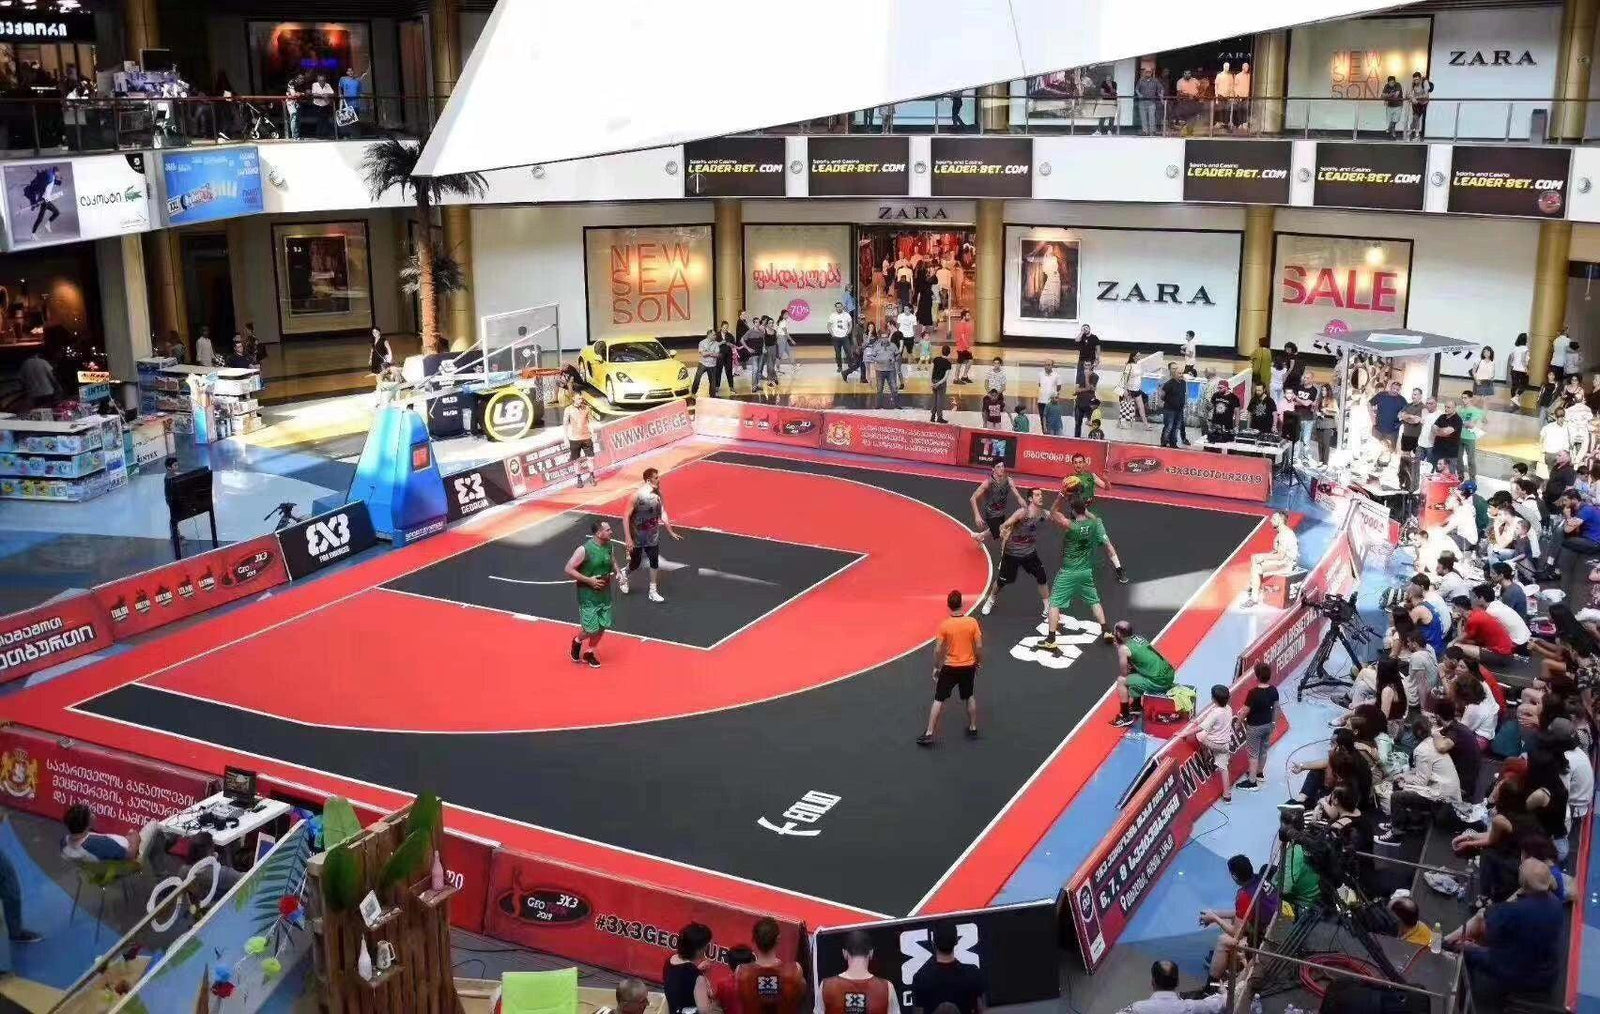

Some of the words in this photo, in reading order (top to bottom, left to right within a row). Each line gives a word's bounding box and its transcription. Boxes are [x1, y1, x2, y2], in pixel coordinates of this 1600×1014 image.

[1333, 50, 1382, 67] NEW
[1449, 49, 1537, 68] ZARA
[1332, 83, 1383, 99] SON
[879, 206, 947, 219] ZARA
[611, 243, 690, 270] NEW
[612, 268, 690, 296] SEA
[1283, 265, 1397, 312] SALE
[1097, 281, 1216, 306] ZARA
[613, 294, 691, 324] SON
[493, 400, 526, 425] LB
[612, 411, 687, 449] WWW.GBF.GE
[46, 758, 124, 790] საქართველოს
[53, 790, 67, 804] და
[527, 897, 546, 910] GEO
[556, 894, 579, 909] 3X3
[536, 910, 553, 921] 2019
